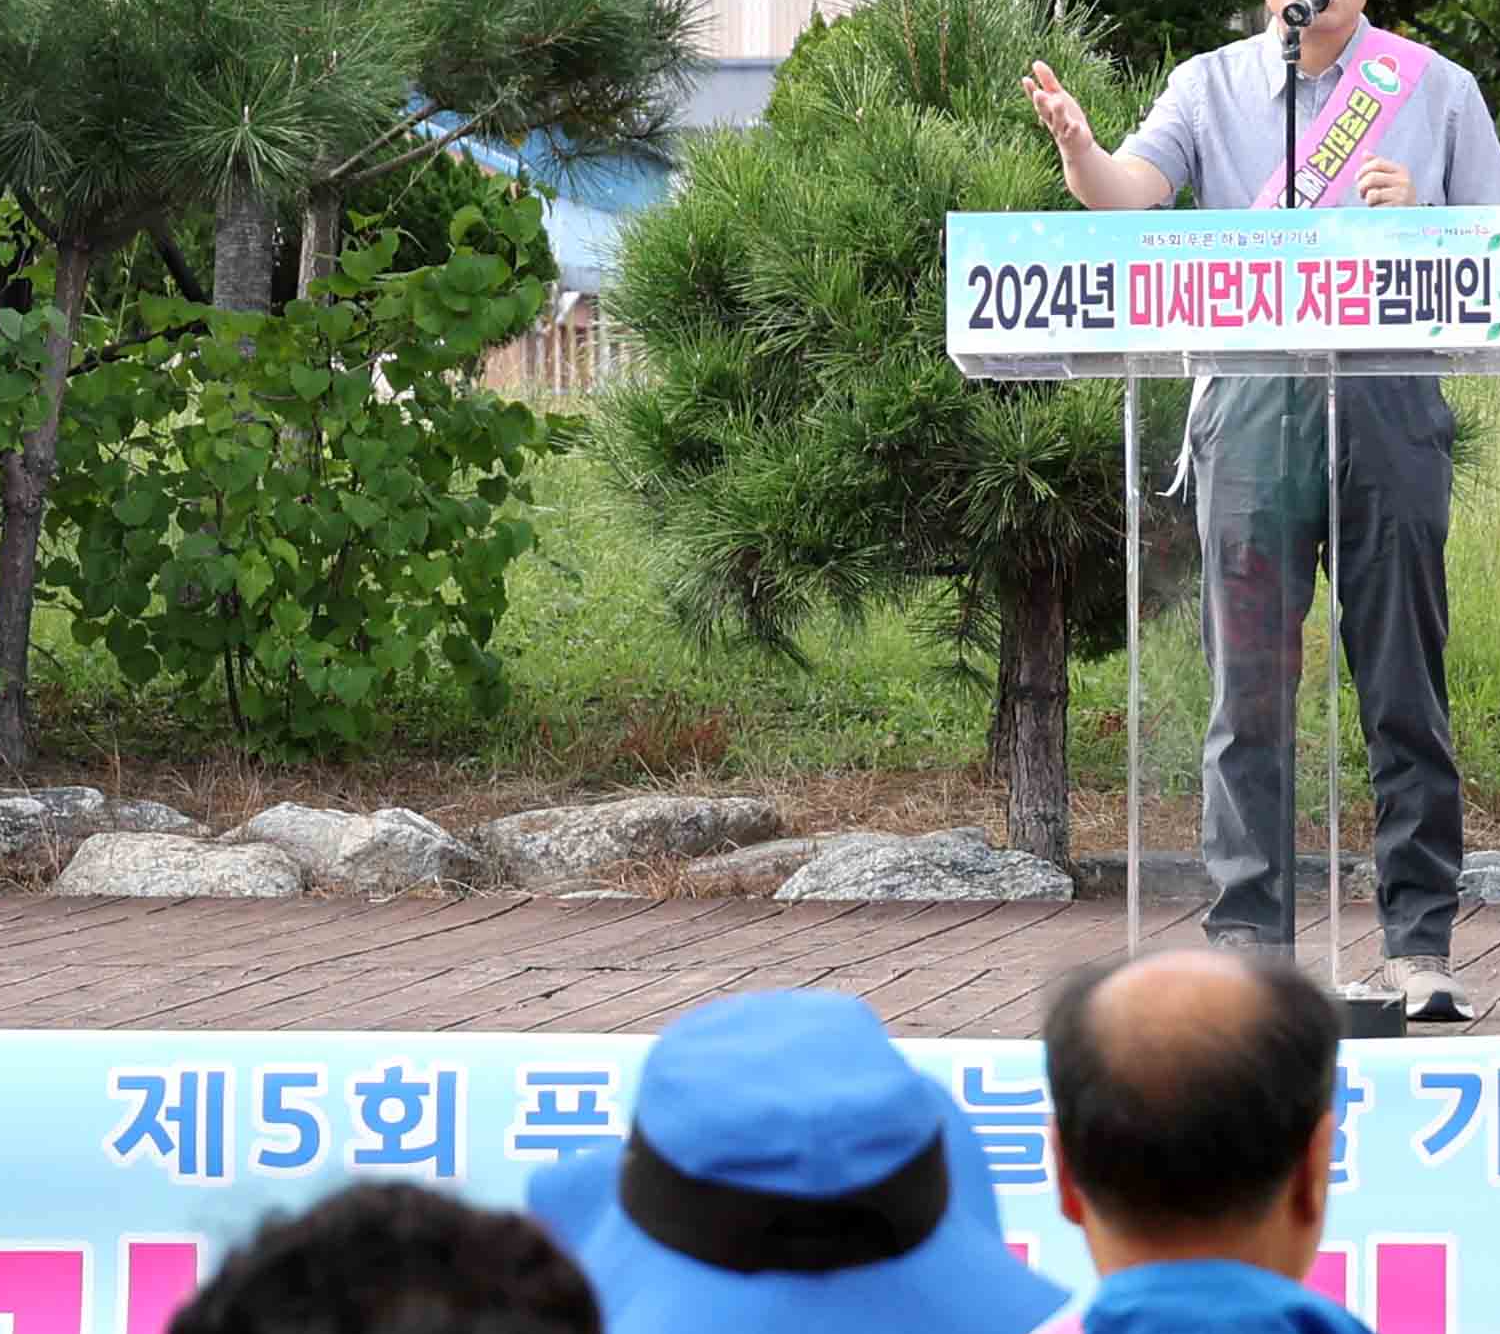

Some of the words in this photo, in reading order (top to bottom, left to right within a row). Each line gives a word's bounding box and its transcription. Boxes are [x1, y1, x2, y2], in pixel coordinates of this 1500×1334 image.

[967, 262, 1115, 330] 2024년
[1128, 261, 1283, 328] 미세먼지
[1296, 257, 1492, 327] 저감캠페인
[111, 1067, 457, 1178] 제5회
